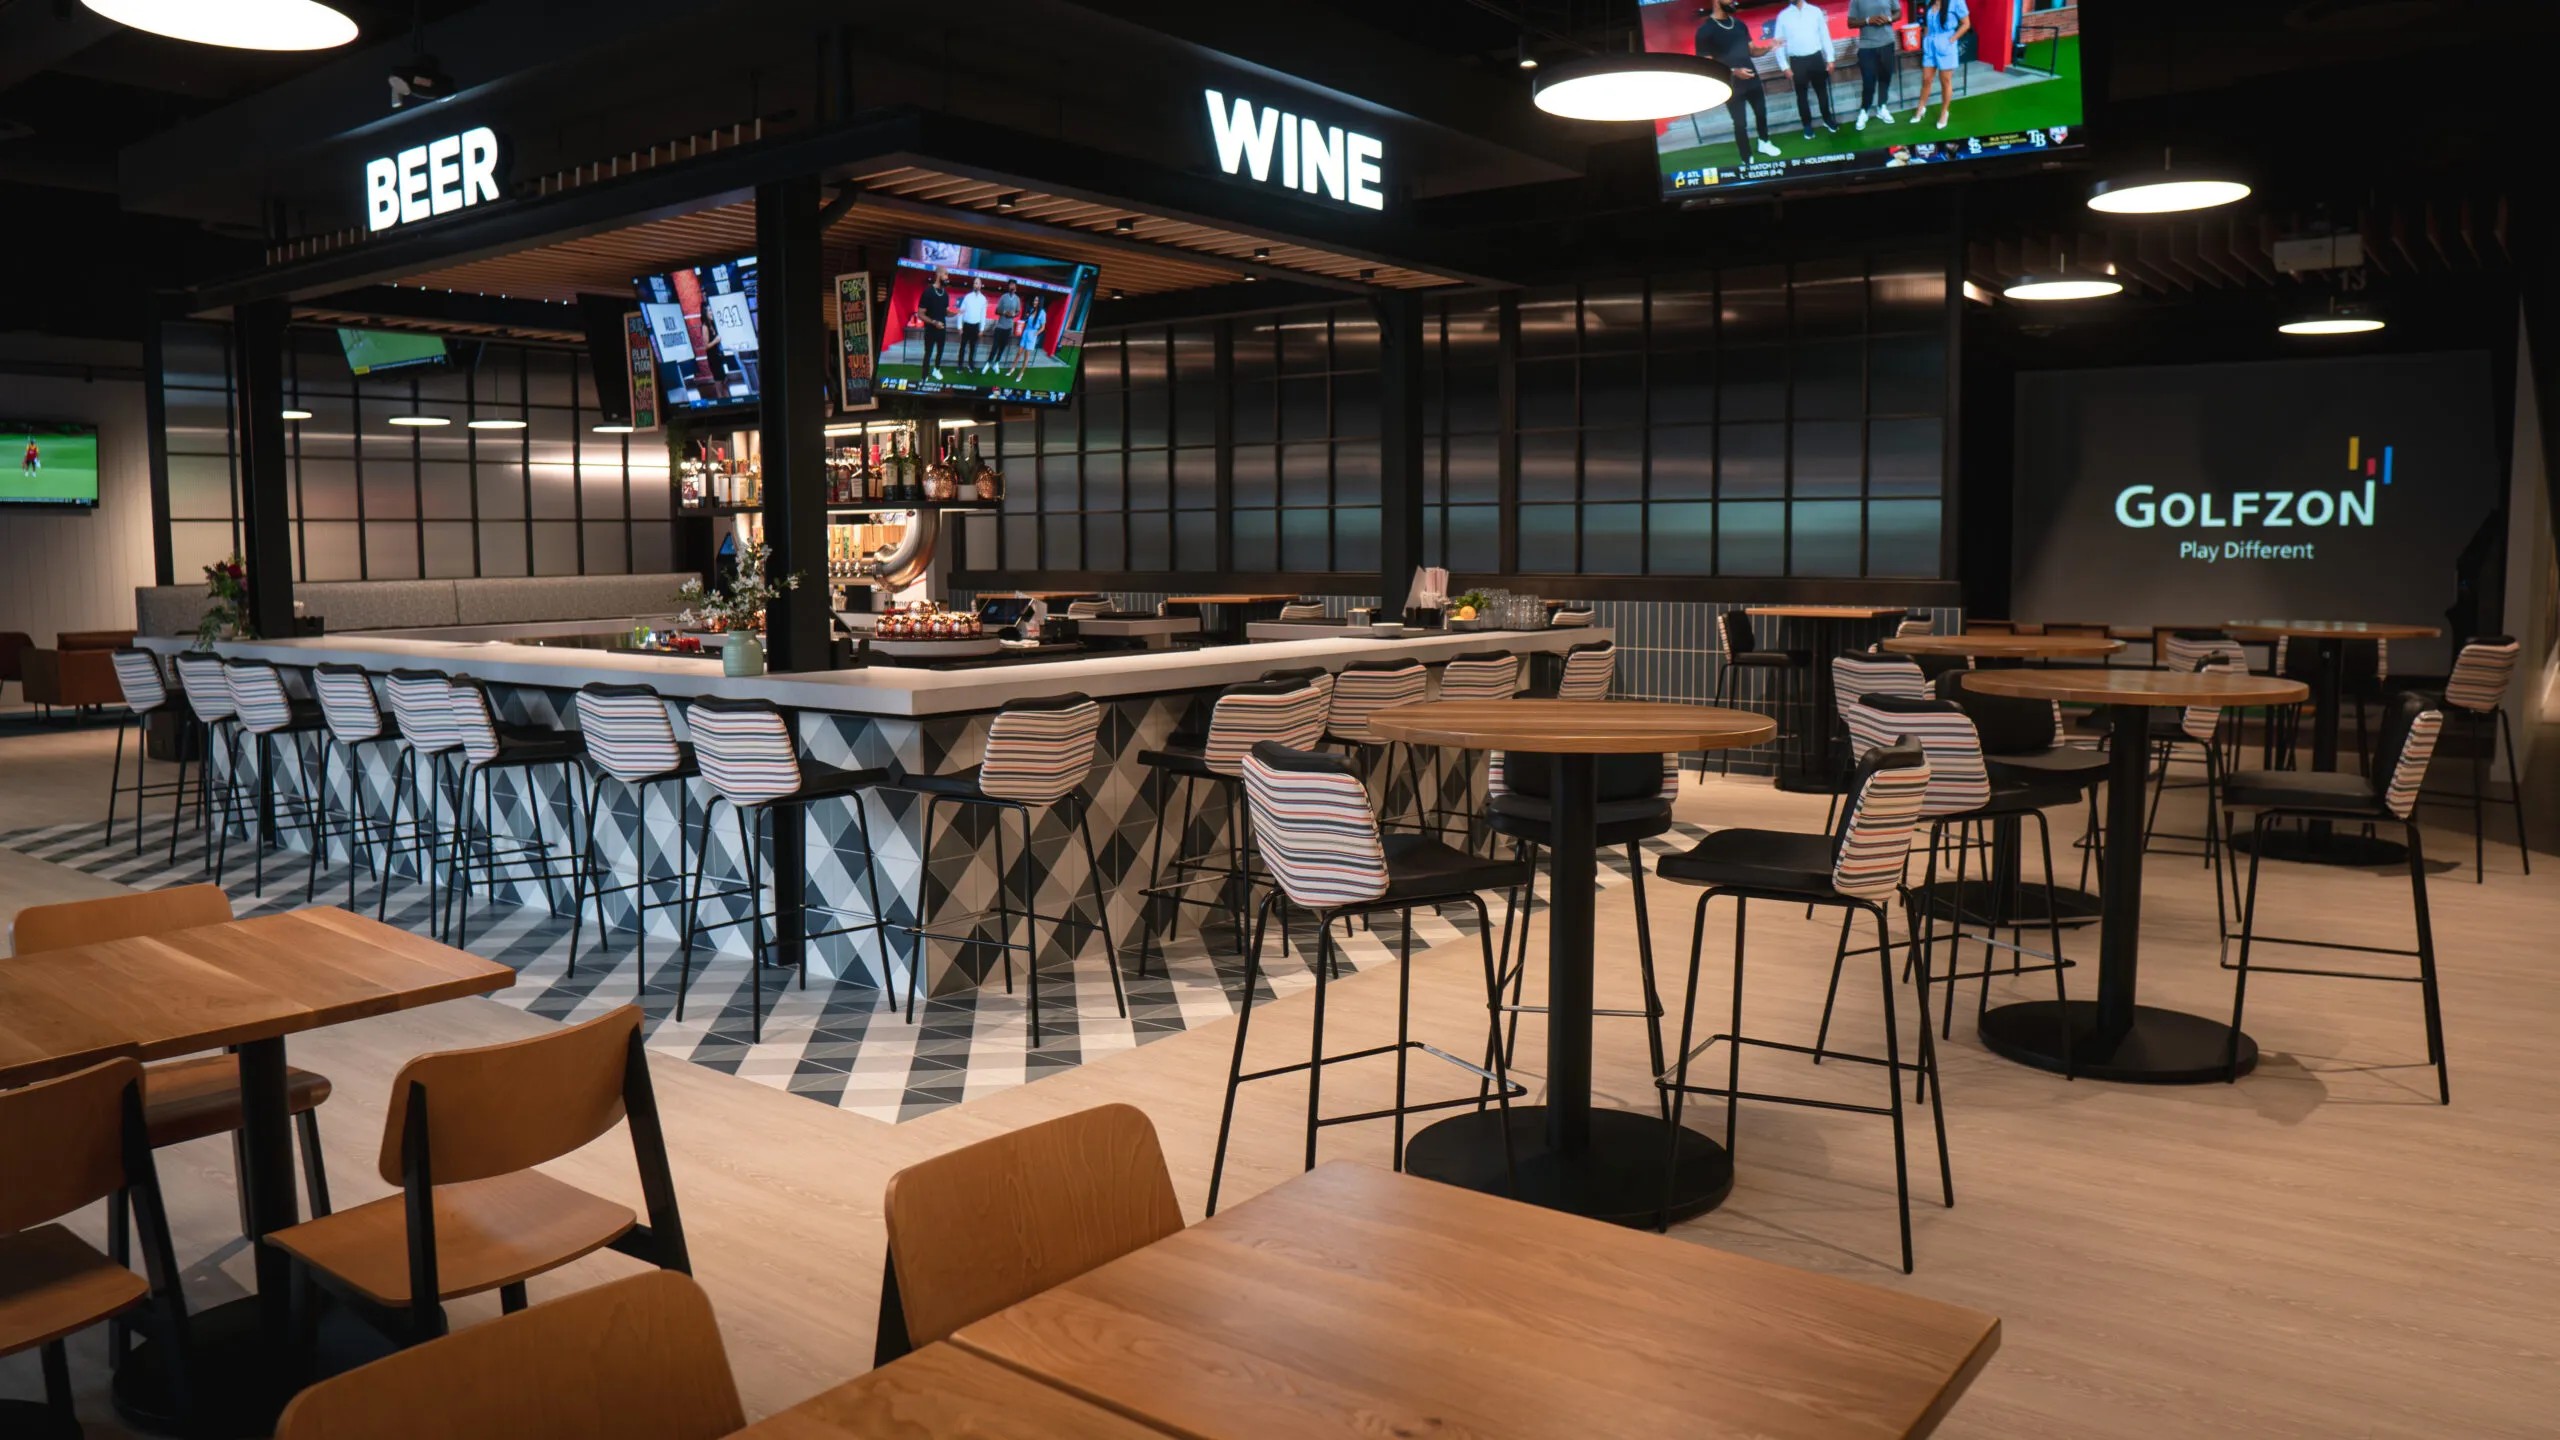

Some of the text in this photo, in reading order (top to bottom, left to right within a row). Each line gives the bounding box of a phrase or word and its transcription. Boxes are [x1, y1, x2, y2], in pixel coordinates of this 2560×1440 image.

[1205, 88, 1383, 211] WINE
[366, 127, 500, 232] BEER
[1686, 170, 1701, 178] ATL
[1687, 178, 1700, 186] PIT
[2114, 479, 2376, 528] GOLFZON
[2180, 541, 2314, 563] Play Different
